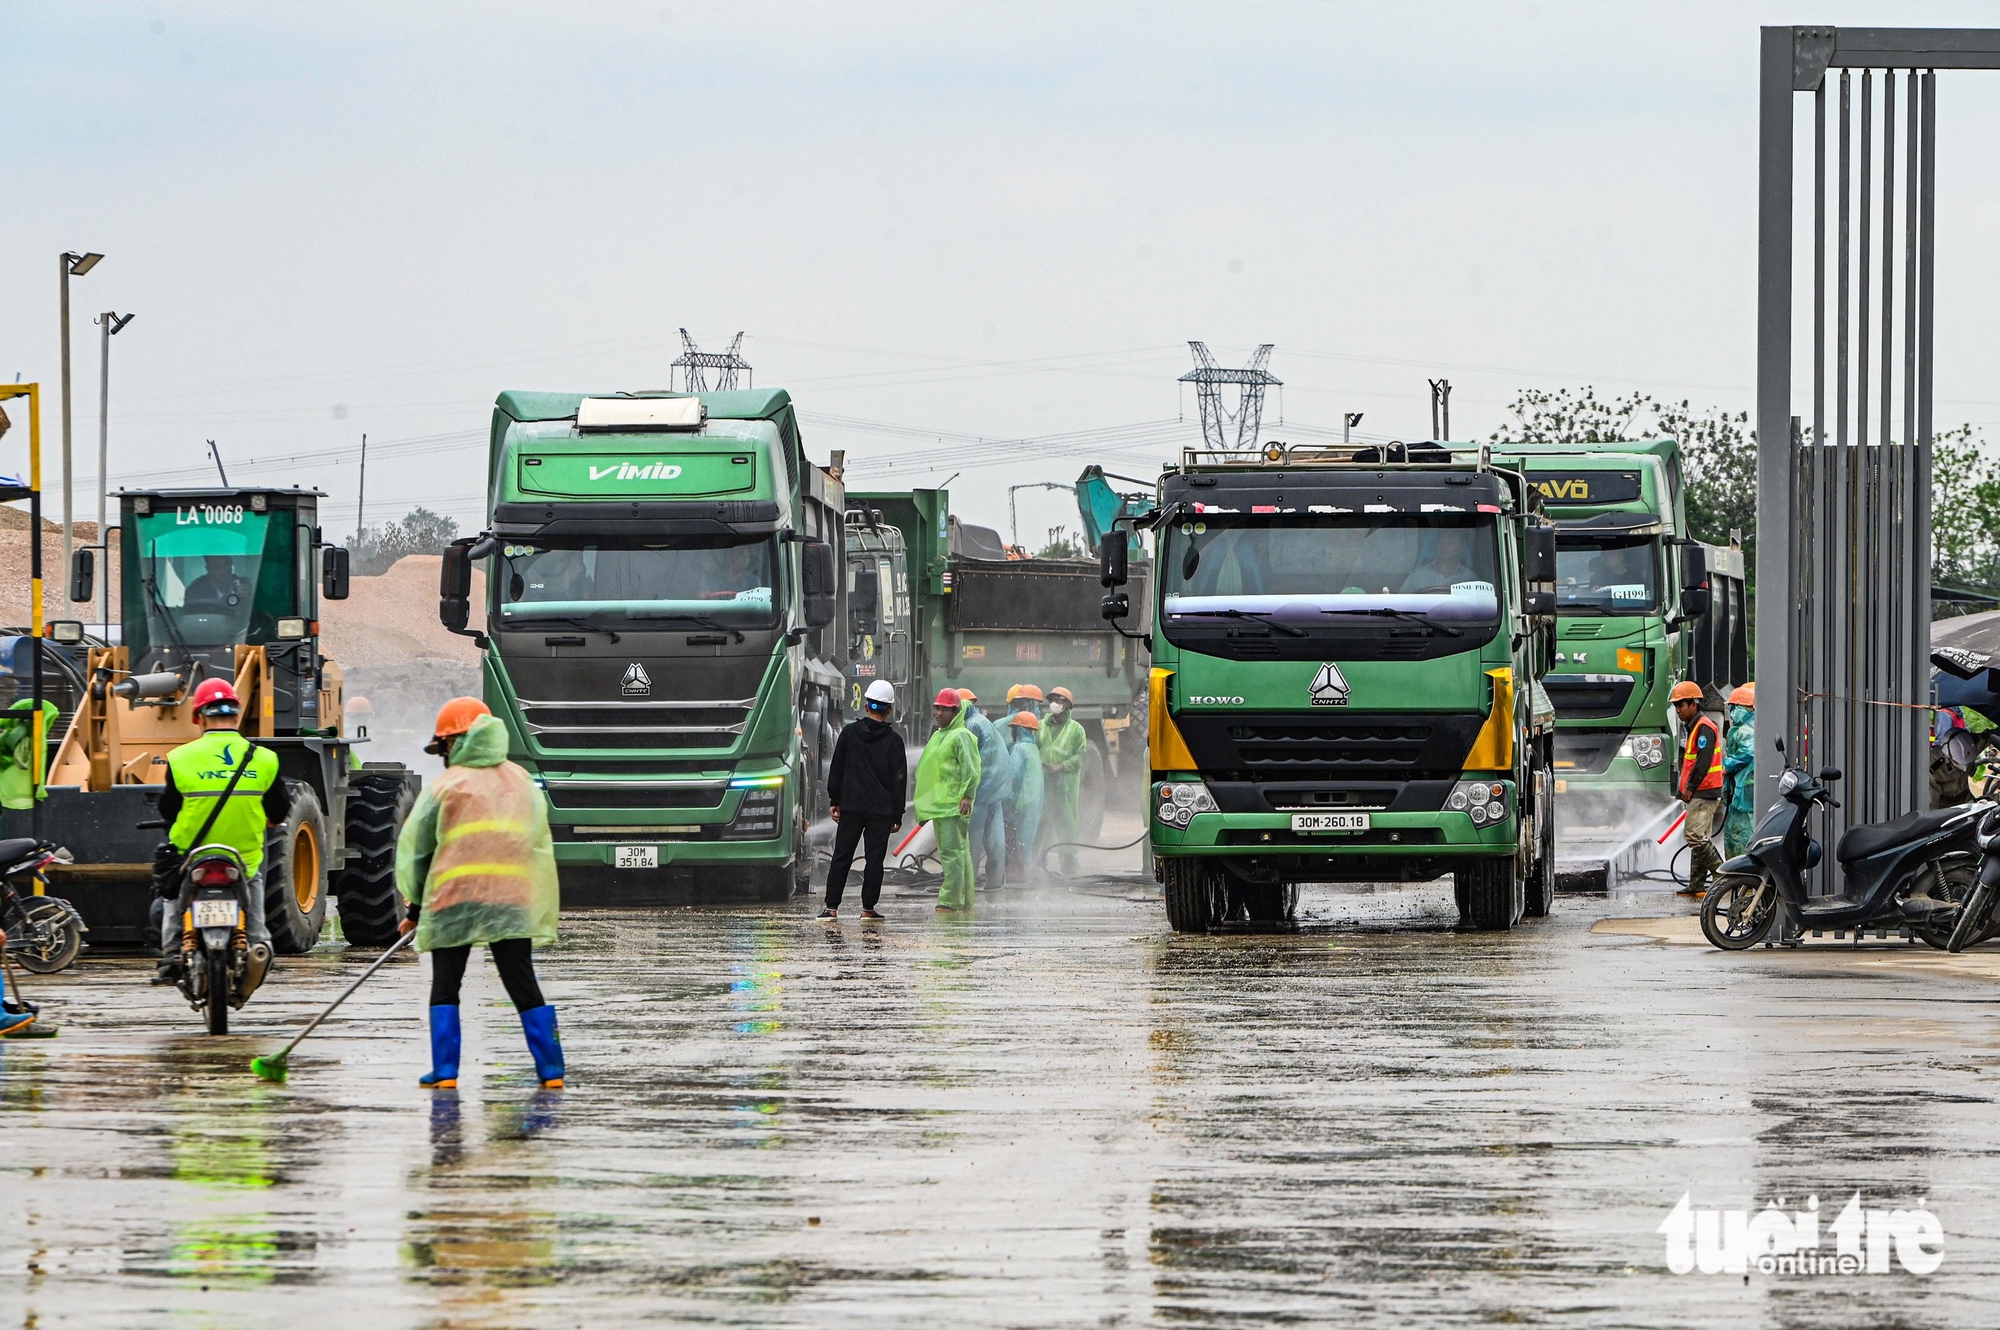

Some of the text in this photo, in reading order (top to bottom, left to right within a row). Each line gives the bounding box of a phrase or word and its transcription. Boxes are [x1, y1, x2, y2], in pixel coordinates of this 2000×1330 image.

[1613, 590, 1644, 599] GH99
[1189, 696, 1246, 705] HOWO
[1298, 816, 1363, 828] 30M-260.18
[627, 847, 646, 857] 30M
[620, 858, 653, 867] 351.84
